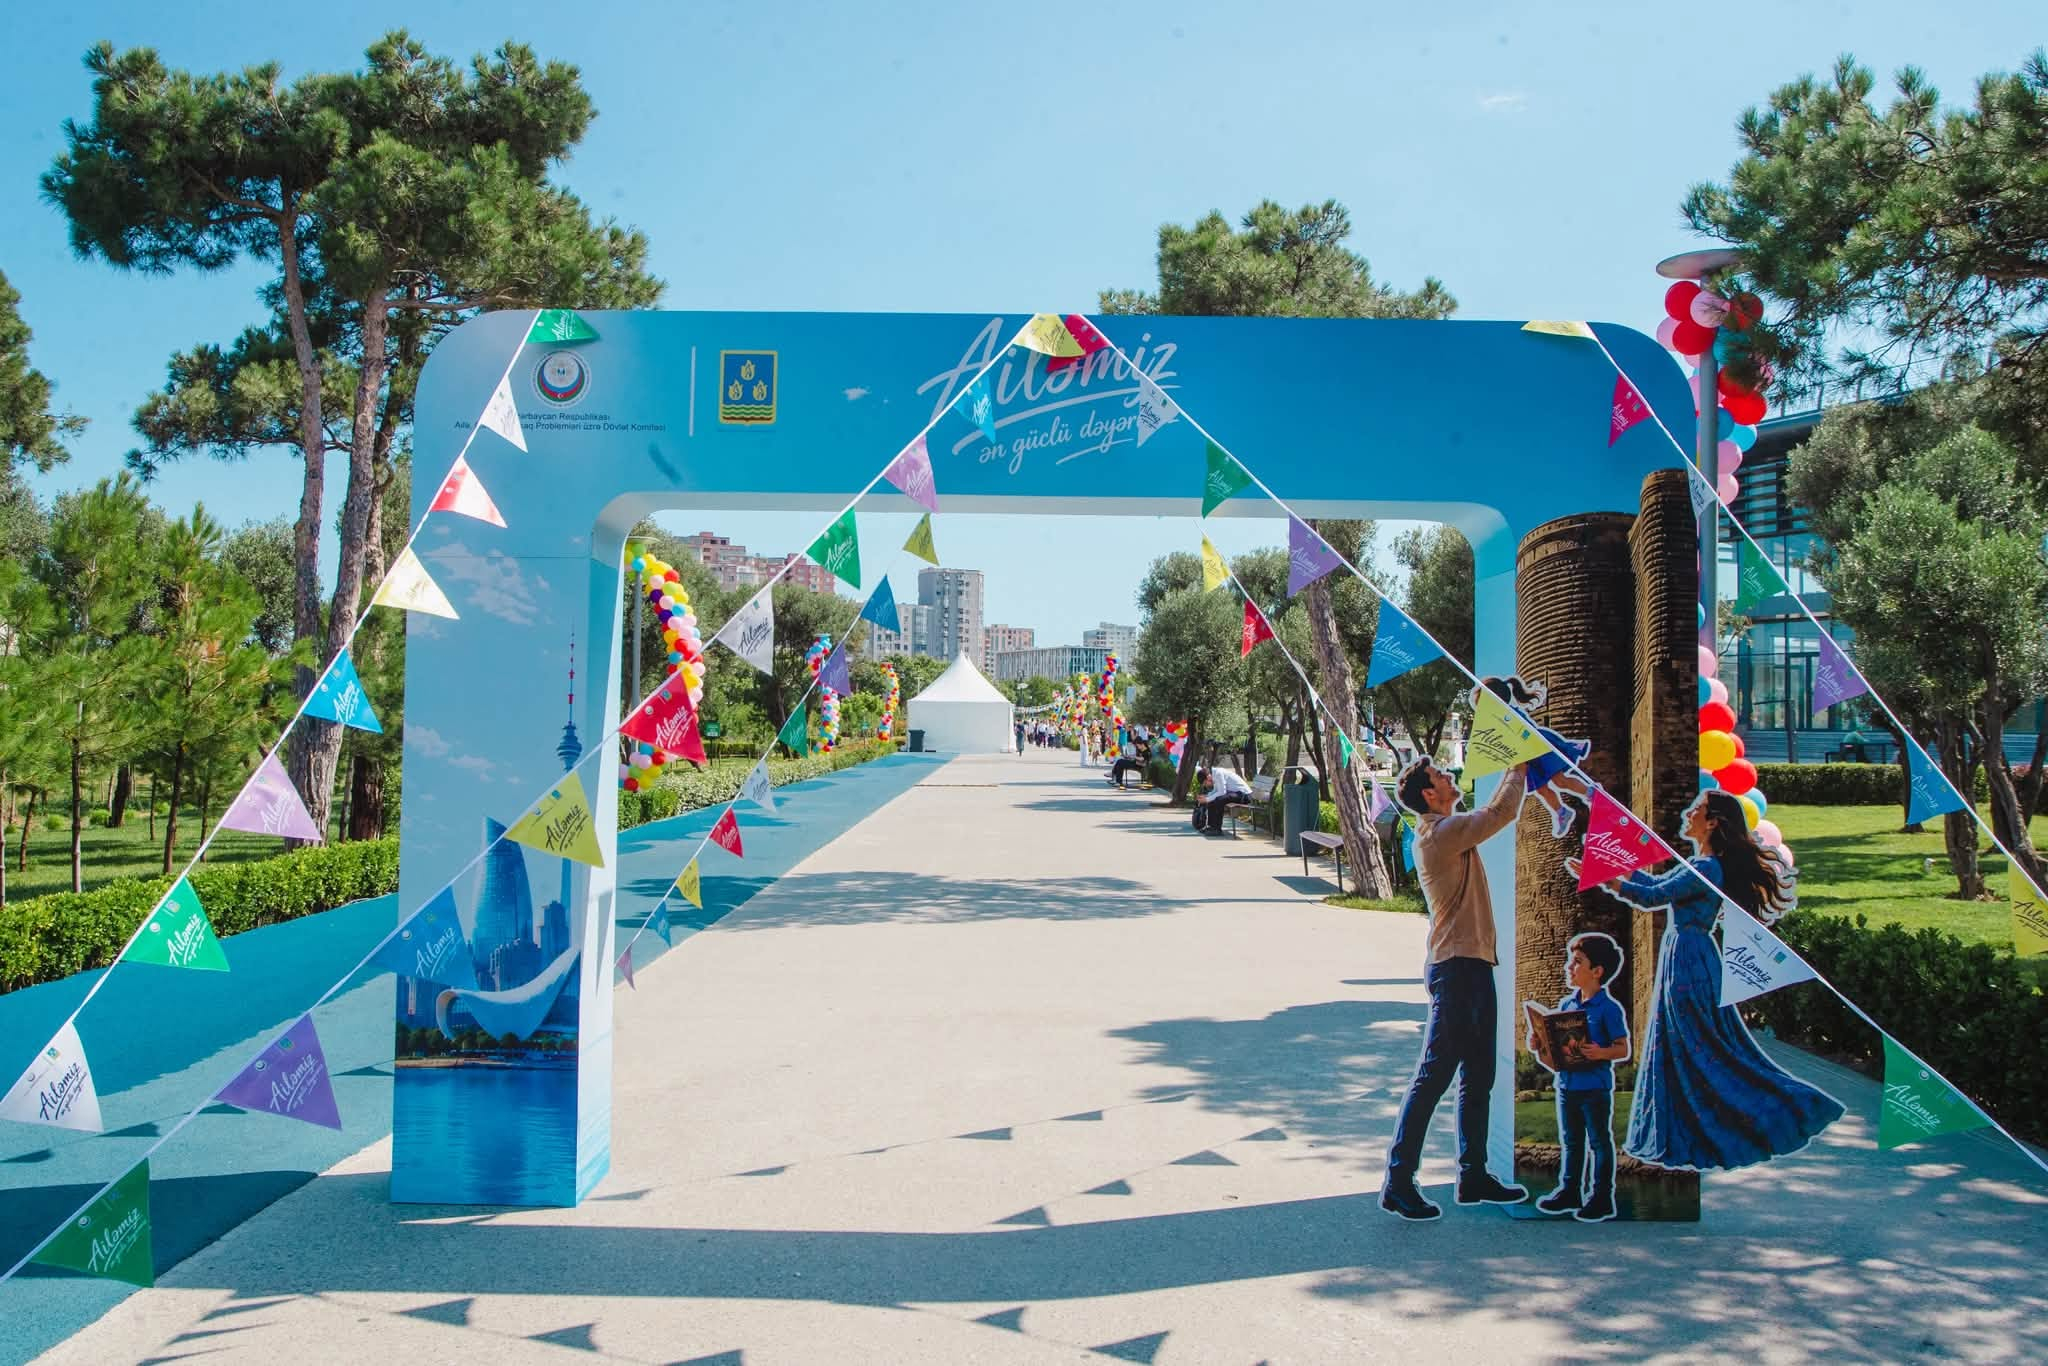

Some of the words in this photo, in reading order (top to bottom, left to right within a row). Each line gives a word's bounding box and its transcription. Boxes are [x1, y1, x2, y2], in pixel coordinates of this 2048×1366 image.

[979, 440, 1006, 464] ən
[1011, 416, 1072, 475] güclü
[545, 804, 584, 852] Ailəmiz
[1587, 831, 1640, 865] Ailəmiz
[167, 913, 202, 966] Ailəmiz
[416, 927, 457, 978] Ailəmiz
[1725, 946, 1772, 984] Ailəmiz
[39, 1061, 81, 1121] Ailəmiz
[269, 1053, 315, 1113] Ailəmiz
[1884, 1082, 1941, 1130] Ailəmiz
[88, 1207, 141, 1273] Ailəmiz
